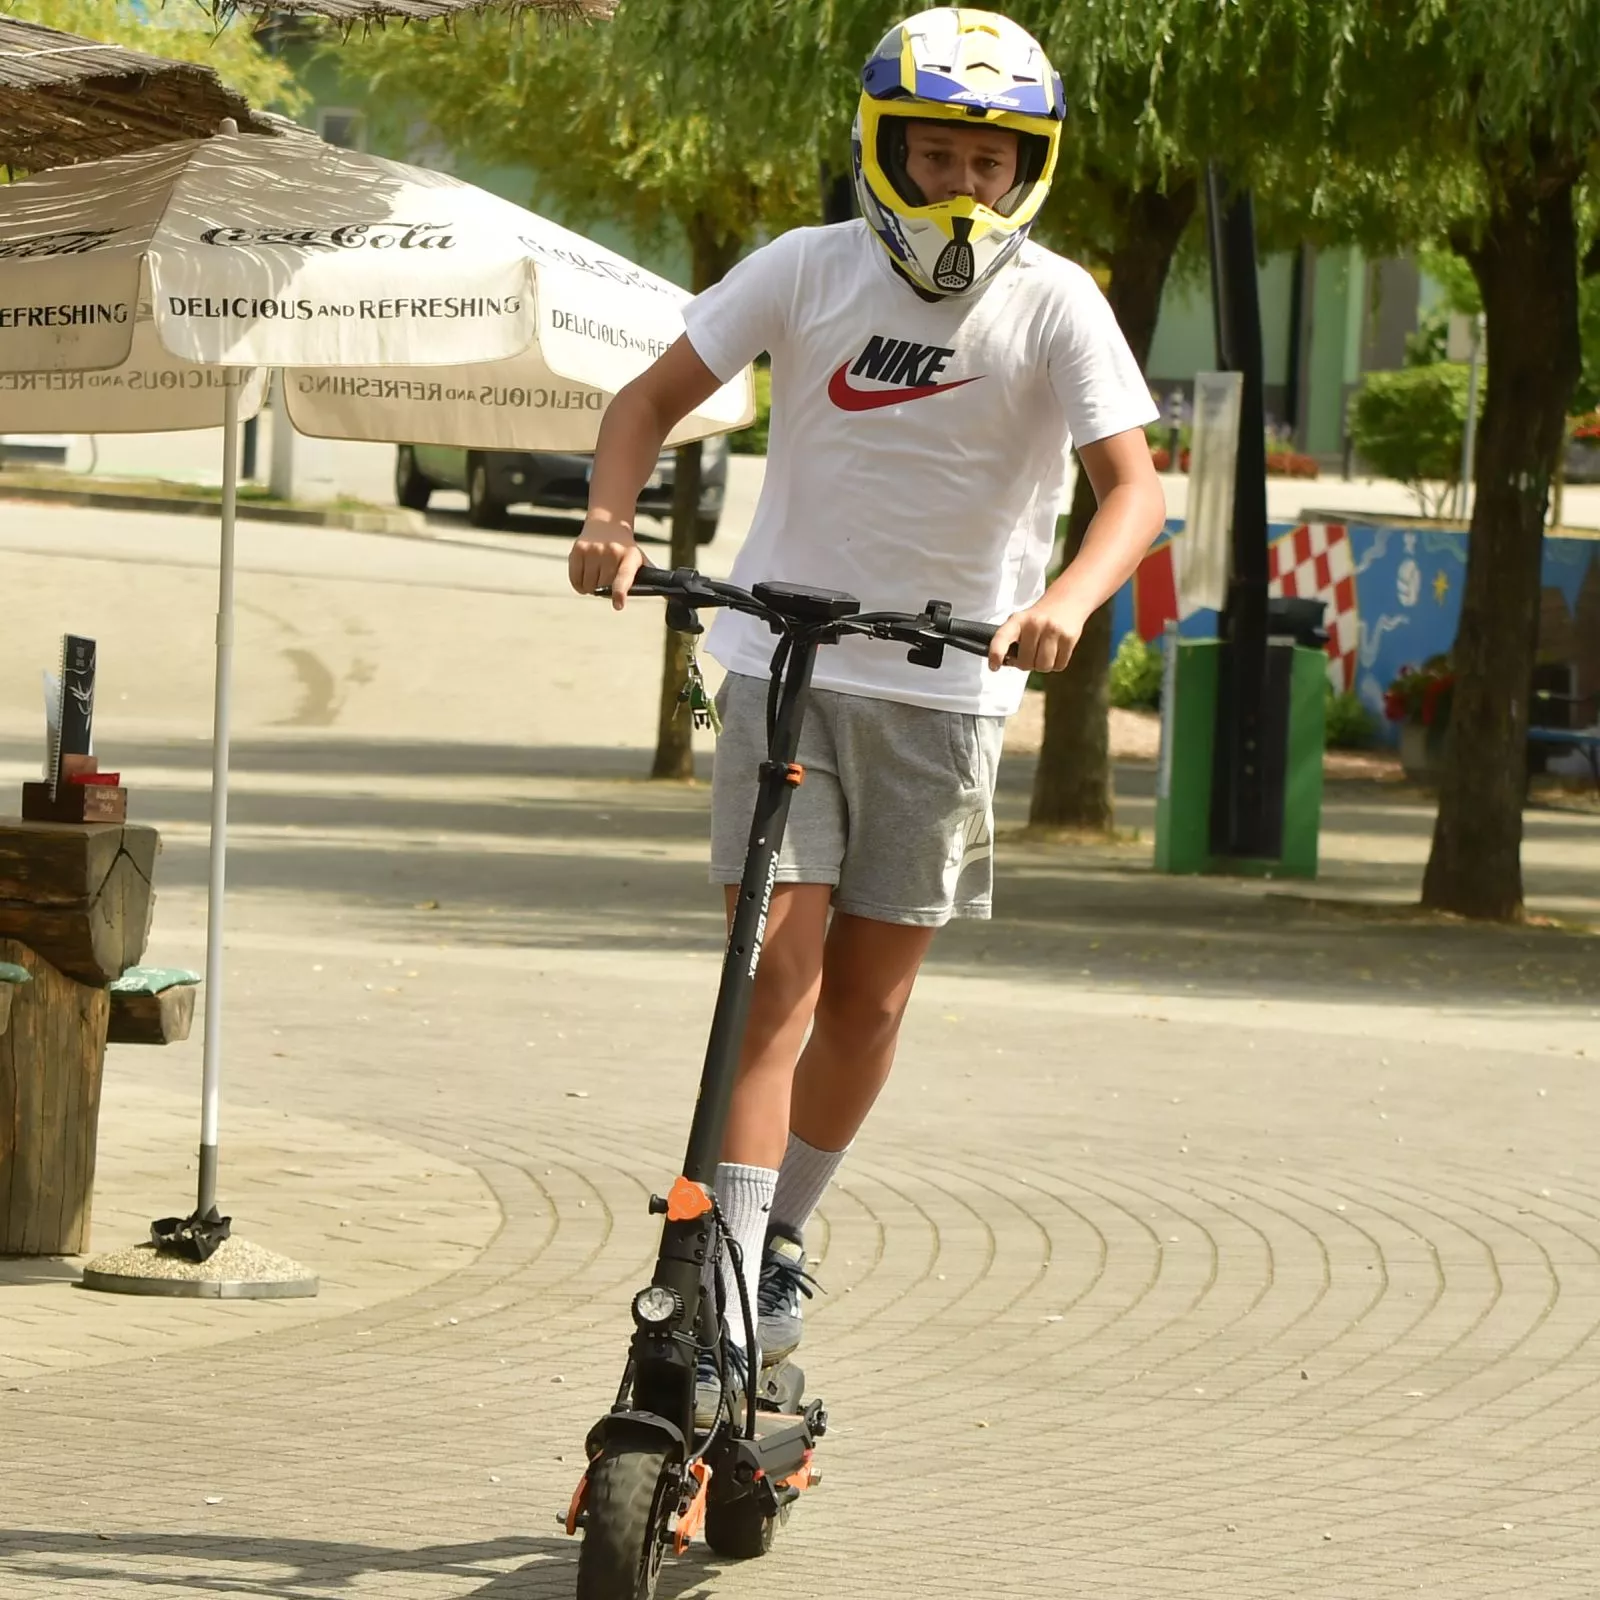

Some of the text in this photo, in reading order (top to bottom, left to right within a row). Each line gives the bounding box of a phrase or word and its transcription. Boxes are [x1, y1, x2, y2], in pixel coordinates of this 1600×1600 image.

[0, 303, 128, 328] EFRESHING
[169, 297, 313, 320] DELICIOUS
[317, 304, 355, 317] AND
[359, 296, 520, 319] REFRESHING
[552, 309, 628, 349] DELICIOUS
[850, 335, 955, 387] NIKE
[755, 913, 767, 944] G2
